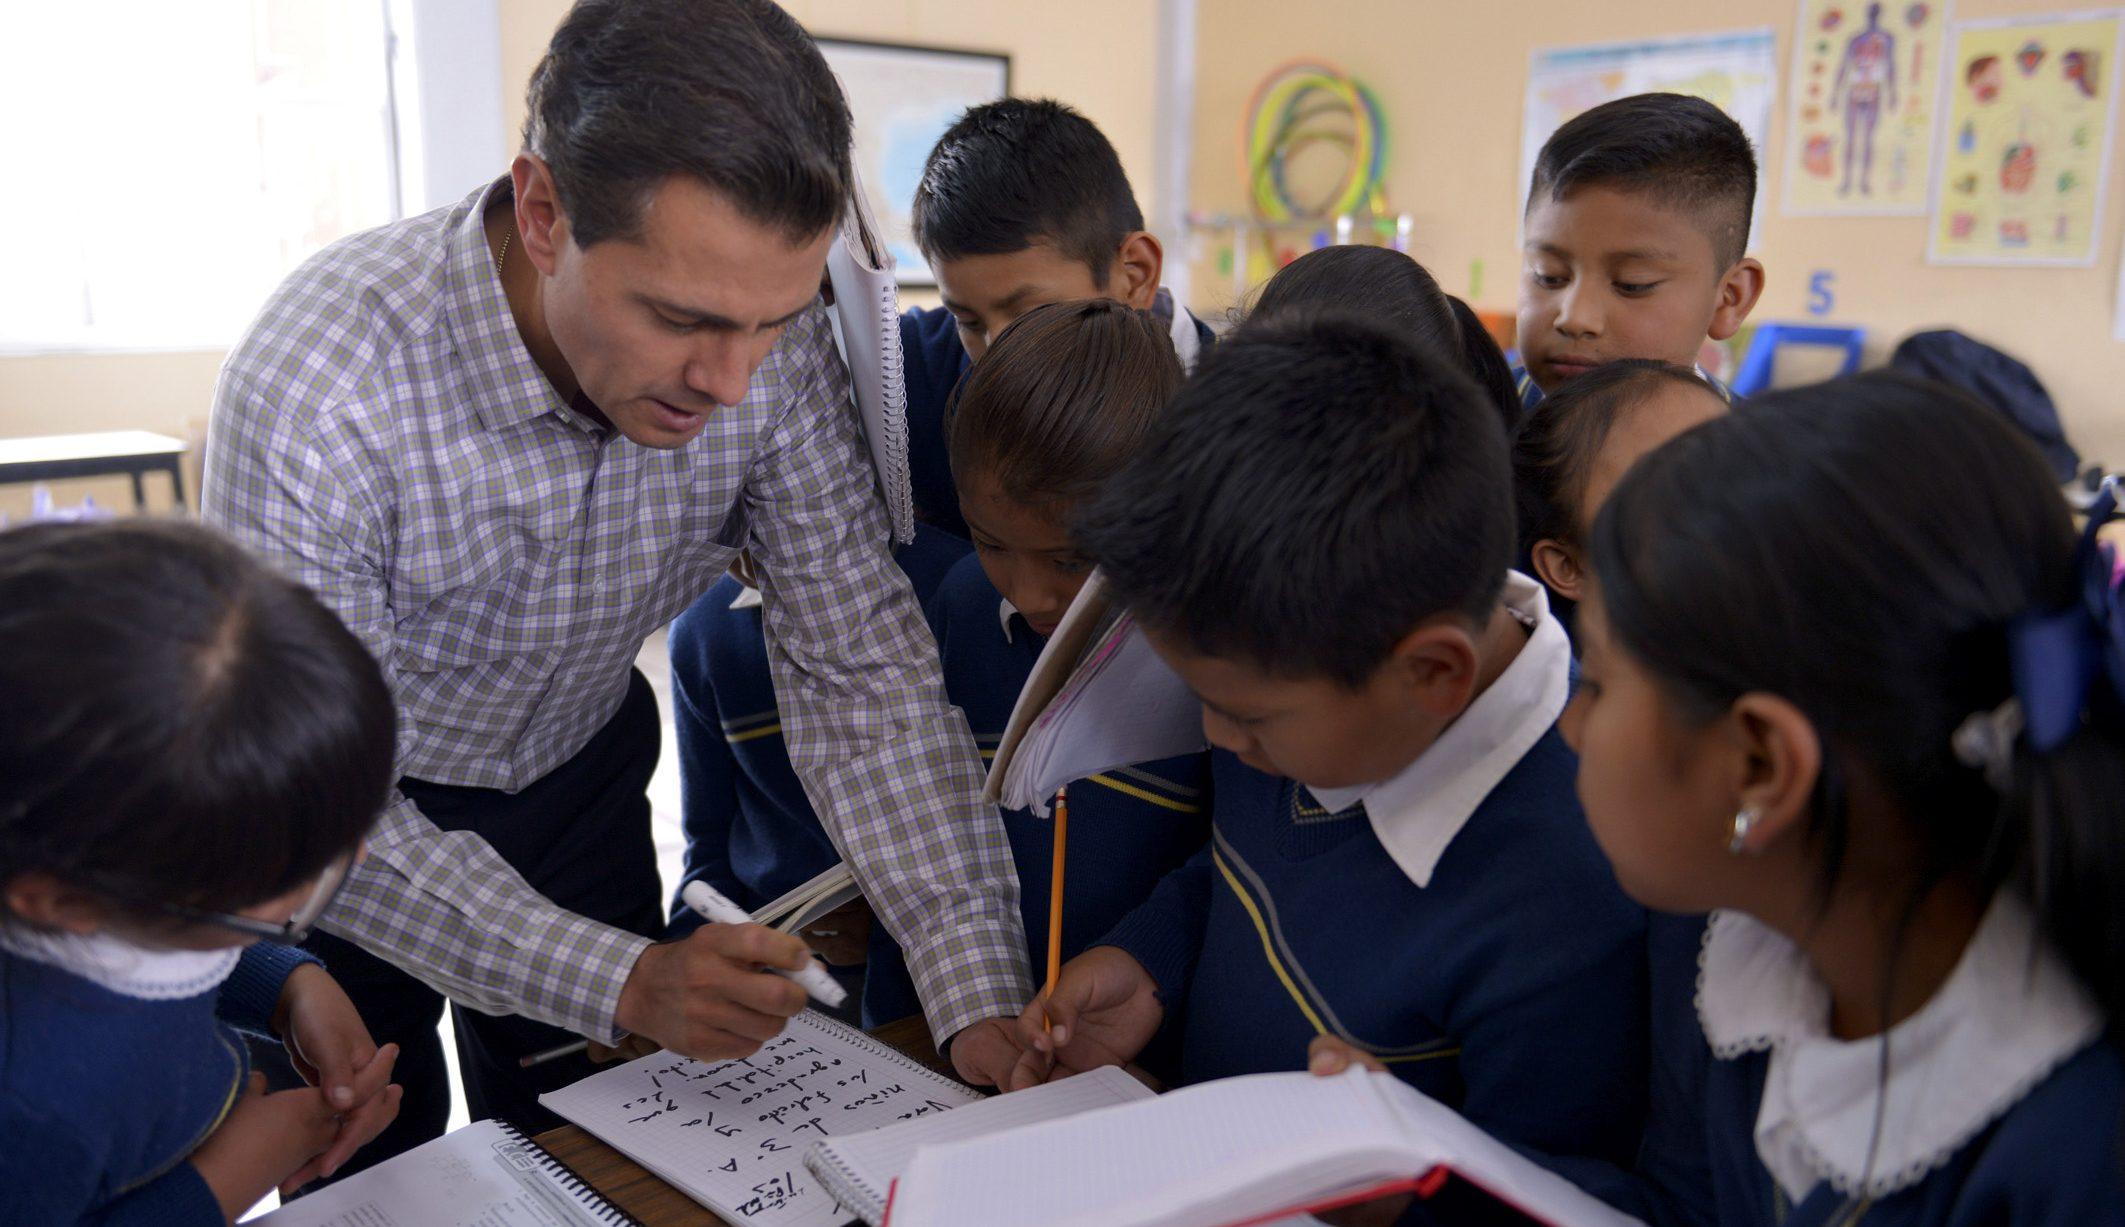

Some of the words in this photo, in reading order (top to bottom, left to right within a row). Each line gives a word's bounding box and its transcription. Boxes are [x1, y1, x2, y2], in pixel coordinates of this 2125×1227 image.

[1808, 269, 1836, 317] 5
[644, 1057, 698, 1088] xito!
[741, 1057, 842, 1105] agradezco
[844, 1084, 906, 1110] niños
[714, 1124, 743, 1138] y
[793, 1117, 829, 1136] de
